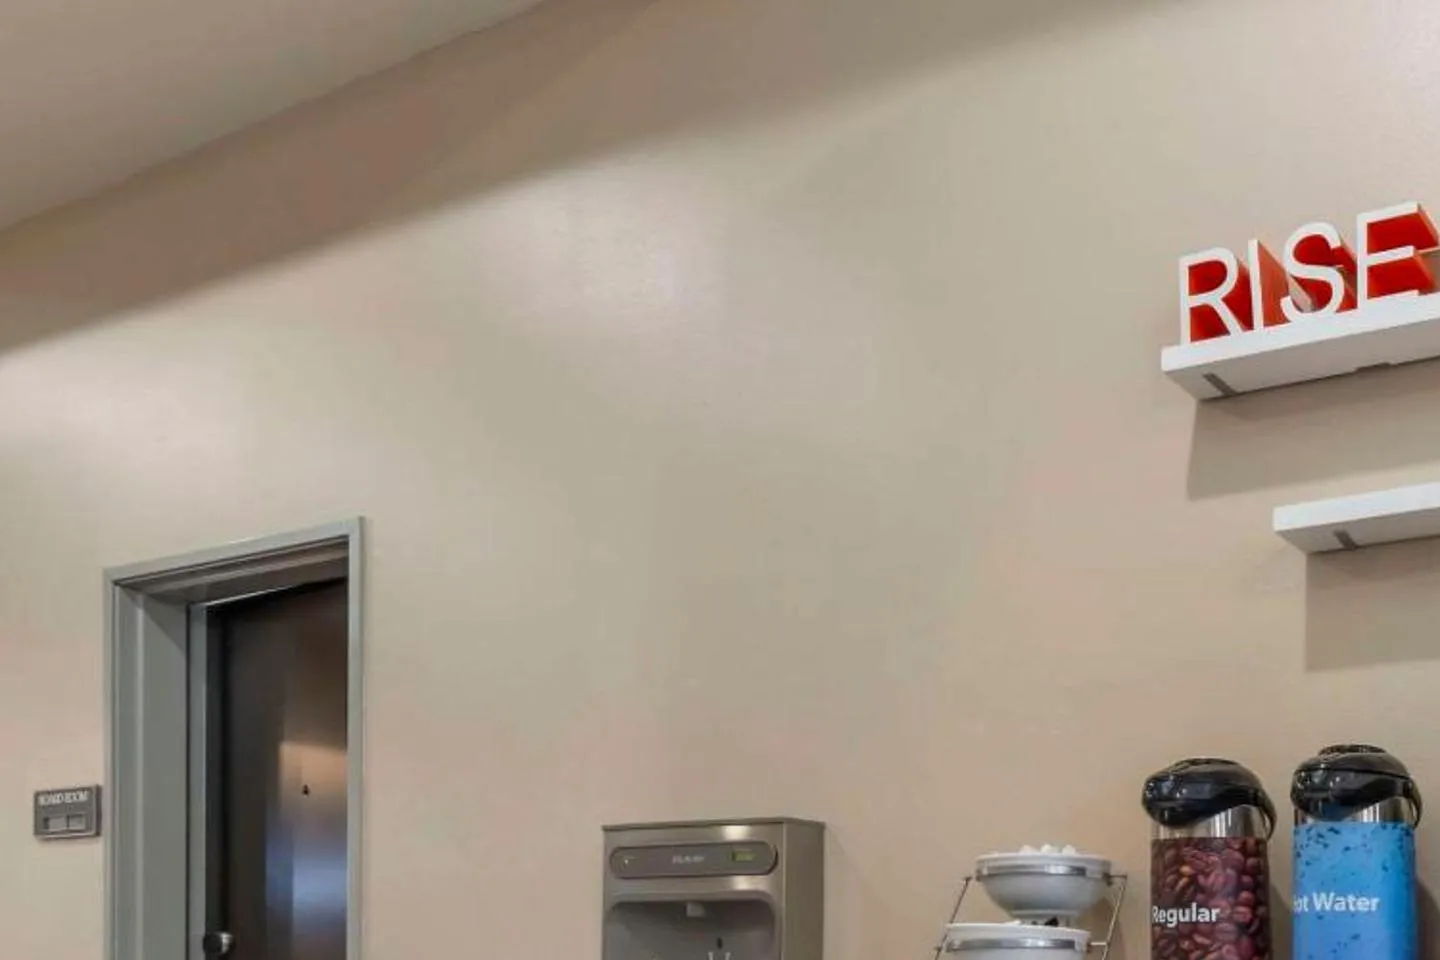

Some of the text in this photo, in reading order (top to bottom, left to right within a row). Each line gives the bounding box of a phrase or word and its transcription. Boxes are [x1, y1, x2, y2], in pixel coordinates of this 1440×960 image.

[1177, 201, 1438, 345] RISE
[1152, 902, 1220, 928] Regular
[1312, 891, 1380, 913] Water
